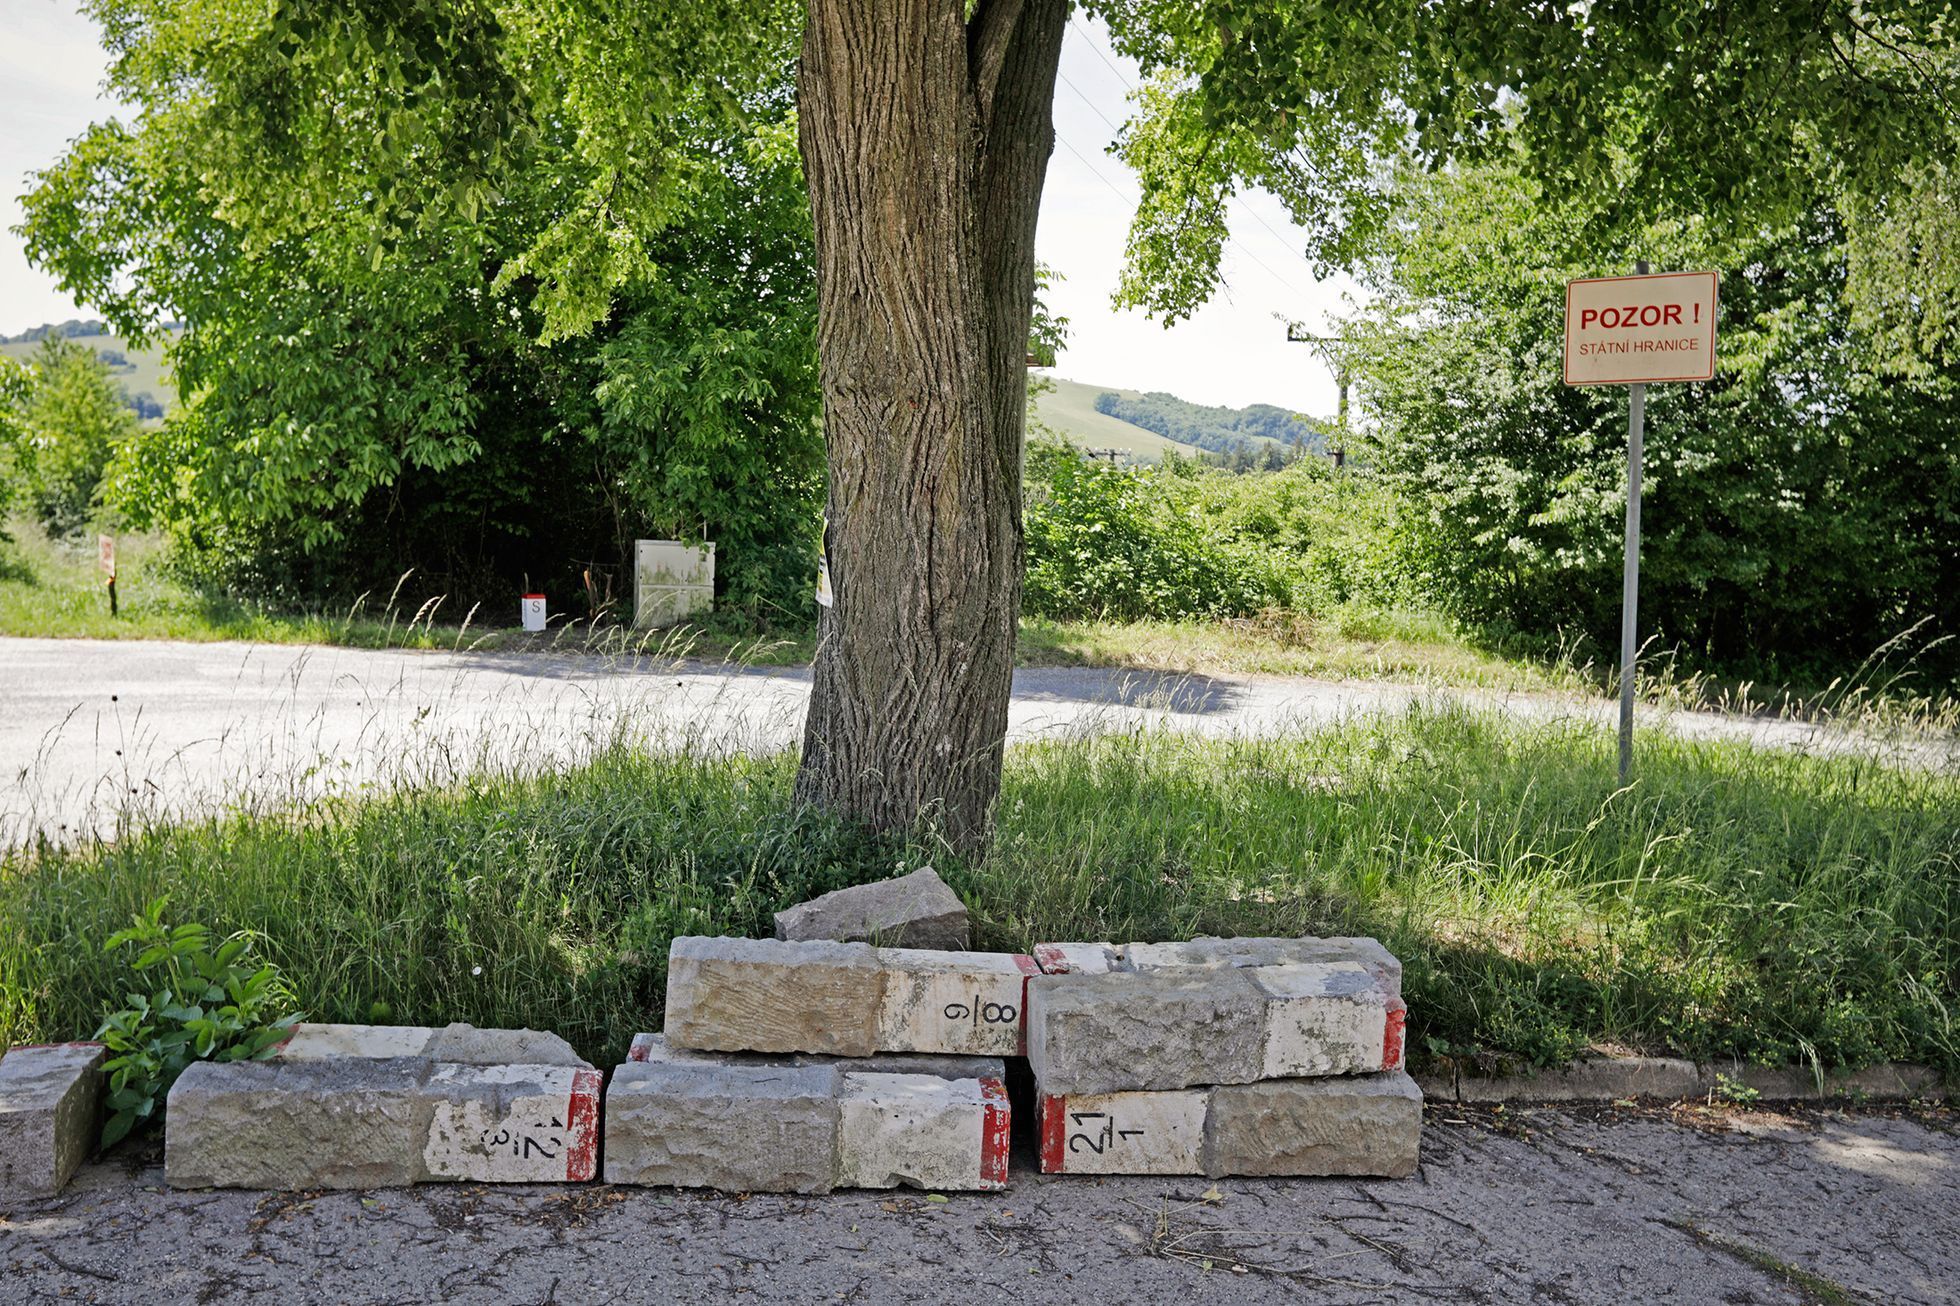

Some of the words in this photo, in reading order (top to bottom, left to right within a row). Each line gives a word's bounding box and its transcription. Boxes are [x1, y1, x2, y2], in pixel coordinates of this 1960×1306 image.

[1580, 304, 1683, 330] POZOR
[1579, 339, 1630, 356] STÁTNÍ
[1633, 338, 1699, 353] HRANICE
[531, 600, 541, 613] S
[982, 1002, 1017, 1024] 8
[1069, 1112, 1106, 1154] 21
